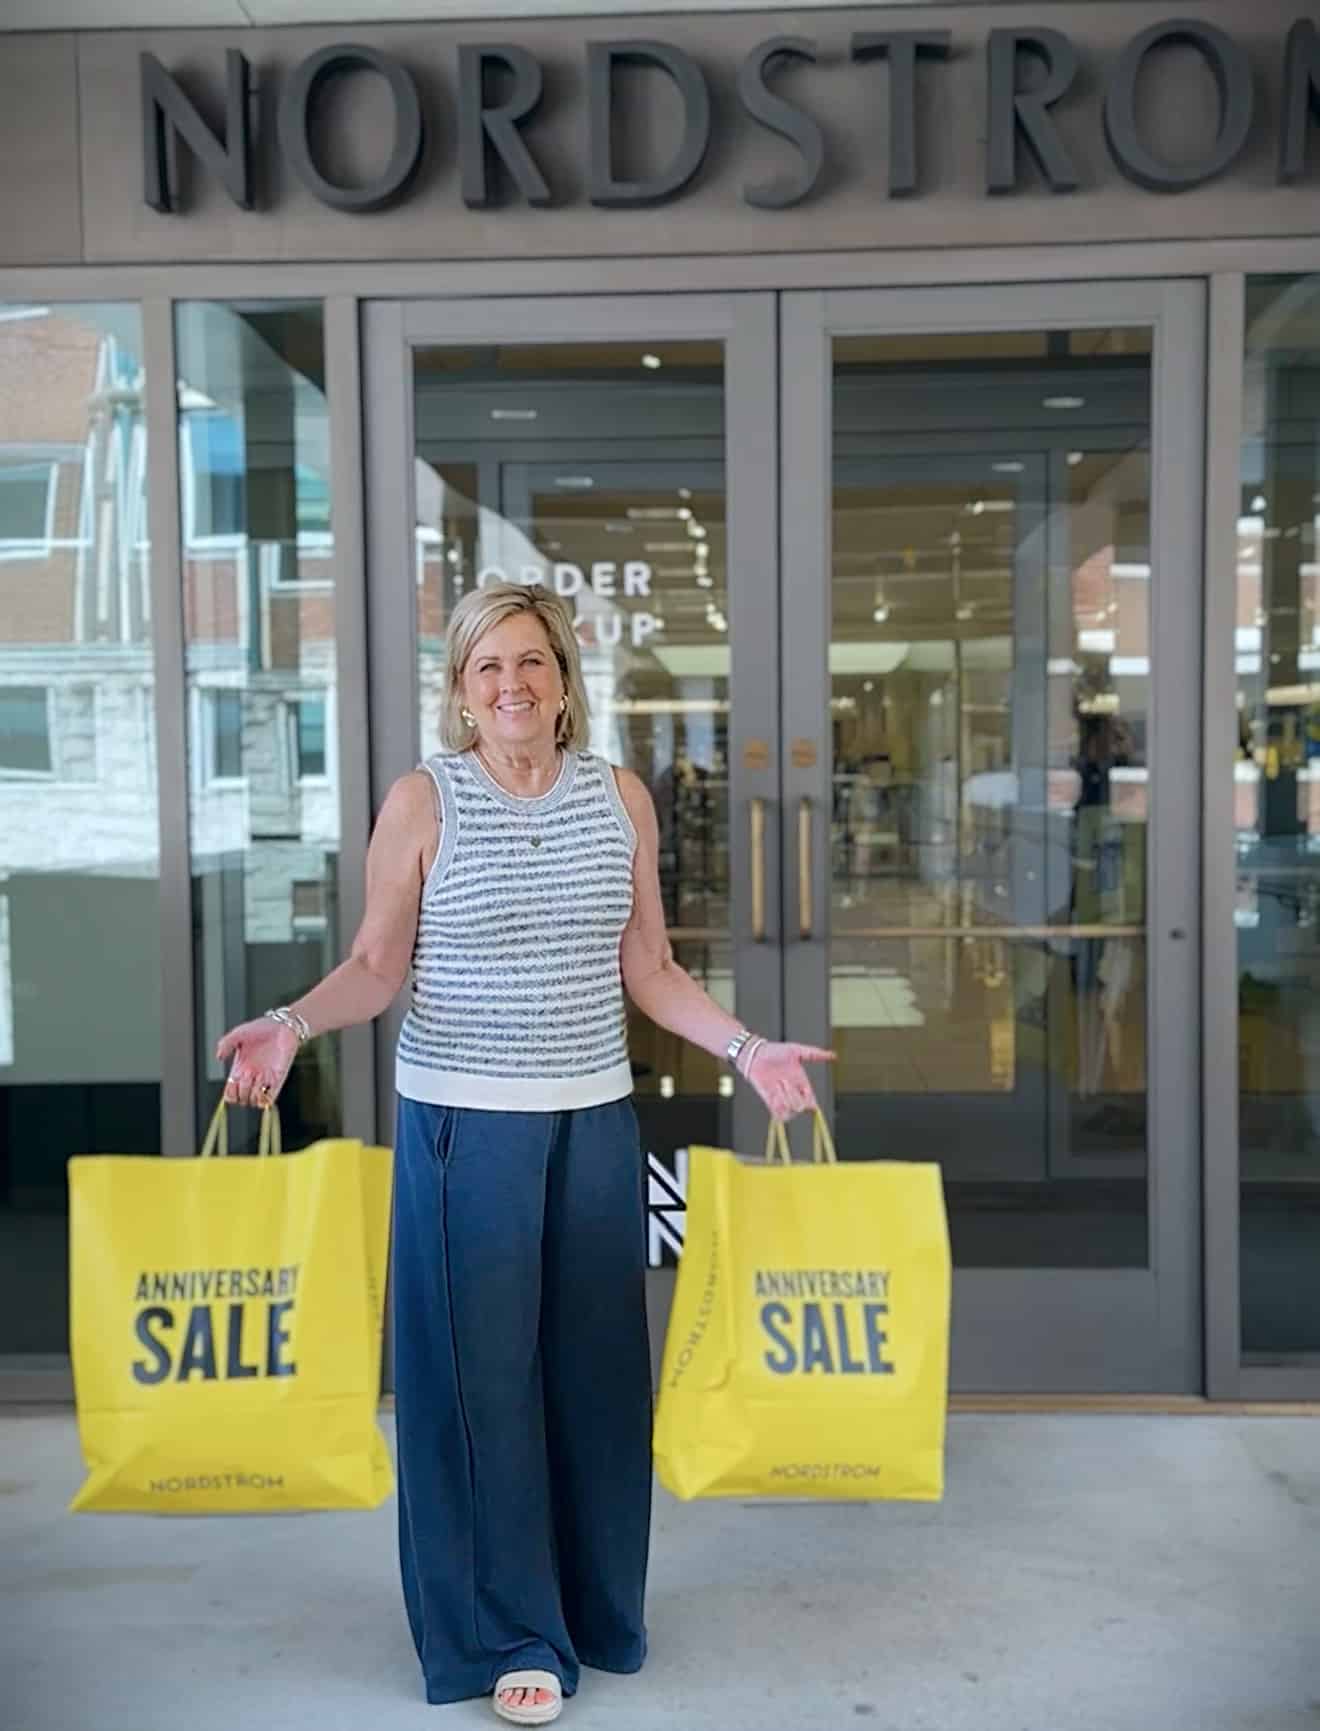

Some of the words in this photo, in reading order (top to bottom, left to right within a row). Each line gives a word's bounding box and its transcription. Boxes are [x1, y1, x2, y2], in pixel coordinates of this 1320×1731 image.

[139, 17, 1320, 213] NORDSTRO
[754, 1270, 890, 1299] ANNIVERSARY
[132, 1300, 297, 1386] SALE
[761, 1302, 896, 1375] SALE
[150, 1473, 284, 1493] NORDSTROM
[769, 1464, 881, 1480] NORDSTROM
